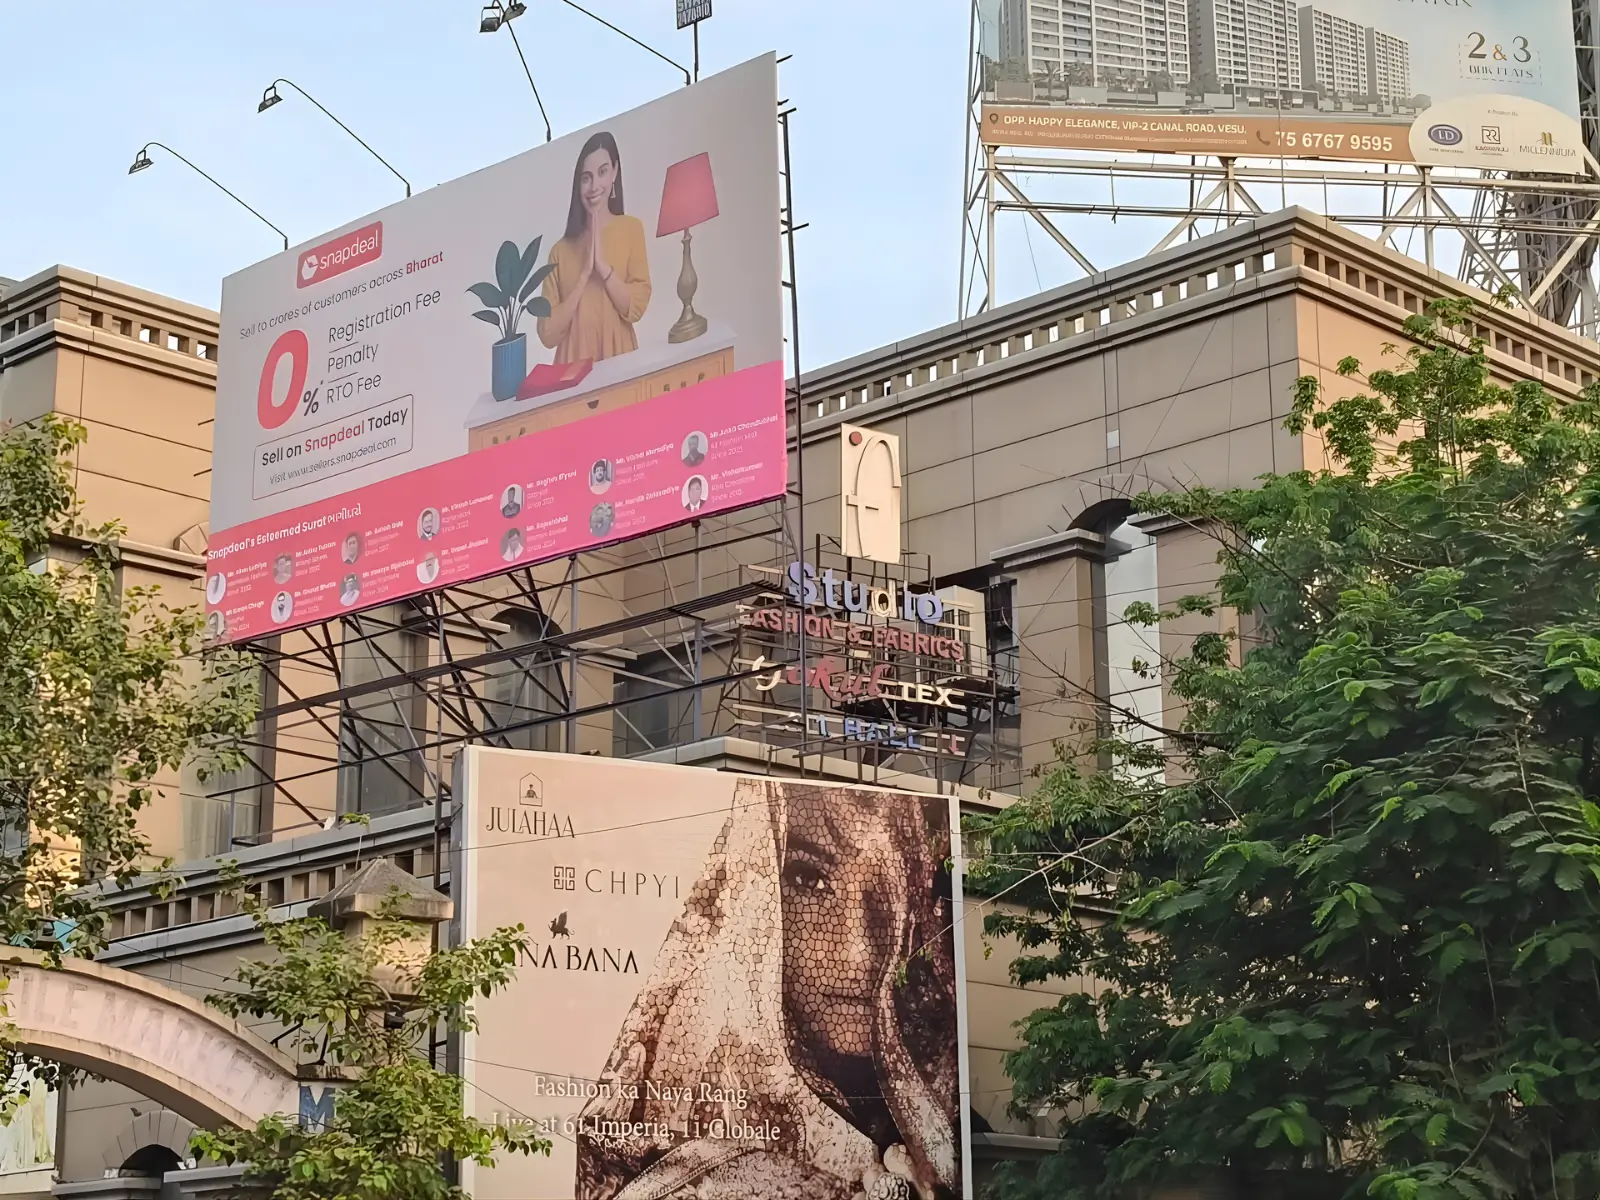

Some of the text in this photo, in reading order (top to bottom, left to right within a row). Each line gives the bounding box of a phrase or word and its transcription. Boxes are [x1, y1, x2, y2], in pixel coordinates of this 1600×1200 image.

[1467, 31, 1532, 63] 2 & 3
[1003, 115, 1027, 125] OPP.
[1028, 115, 1063, 127] HAPPY
[1065, 118, 1121, 130] ELEGANCE,
[1122, 120, 1149, 131] VIP-2
[1150, 122, 1184, 132] CANAL
[1186, 123, 1217, 134] ROAD,
[1275, 130, 1393, 152] 75 6767 9595
[319, 230, 380, 270] snapdeal
[239, 251, 444, 340] Sell to crores of customers across Bharat
[328, 290, 441, 343] Registration Fee
[327, 343, 379, 373] Penalty
[326, 373, 382, 405] RTO Fee
[261, 408, 409, 467] Sell on Snapdeal Today
[269, 437, 398, 485] Visit www.sellers.snapdeal.com
[207, 515, 327, 560] Snapdeal's Esteemed Surat
[787, 560, 944, 625] Studio
[735, 604, 965, 662] FASHON & FABRICS
[897, 681, 953, 707] TEX
[485, 806, 576, 839] JULAHAA
[585, 868, 680, 899] CHPYI
[566, 944, 640, 975] BANA
[533, 1075, 748, 1110] Fashion ka Naya Rang
[540, 1115, 558, 1134] at
[593, 1114, 676, 1143] Imperia,
[708, 1118, 781, 1142] Globale
